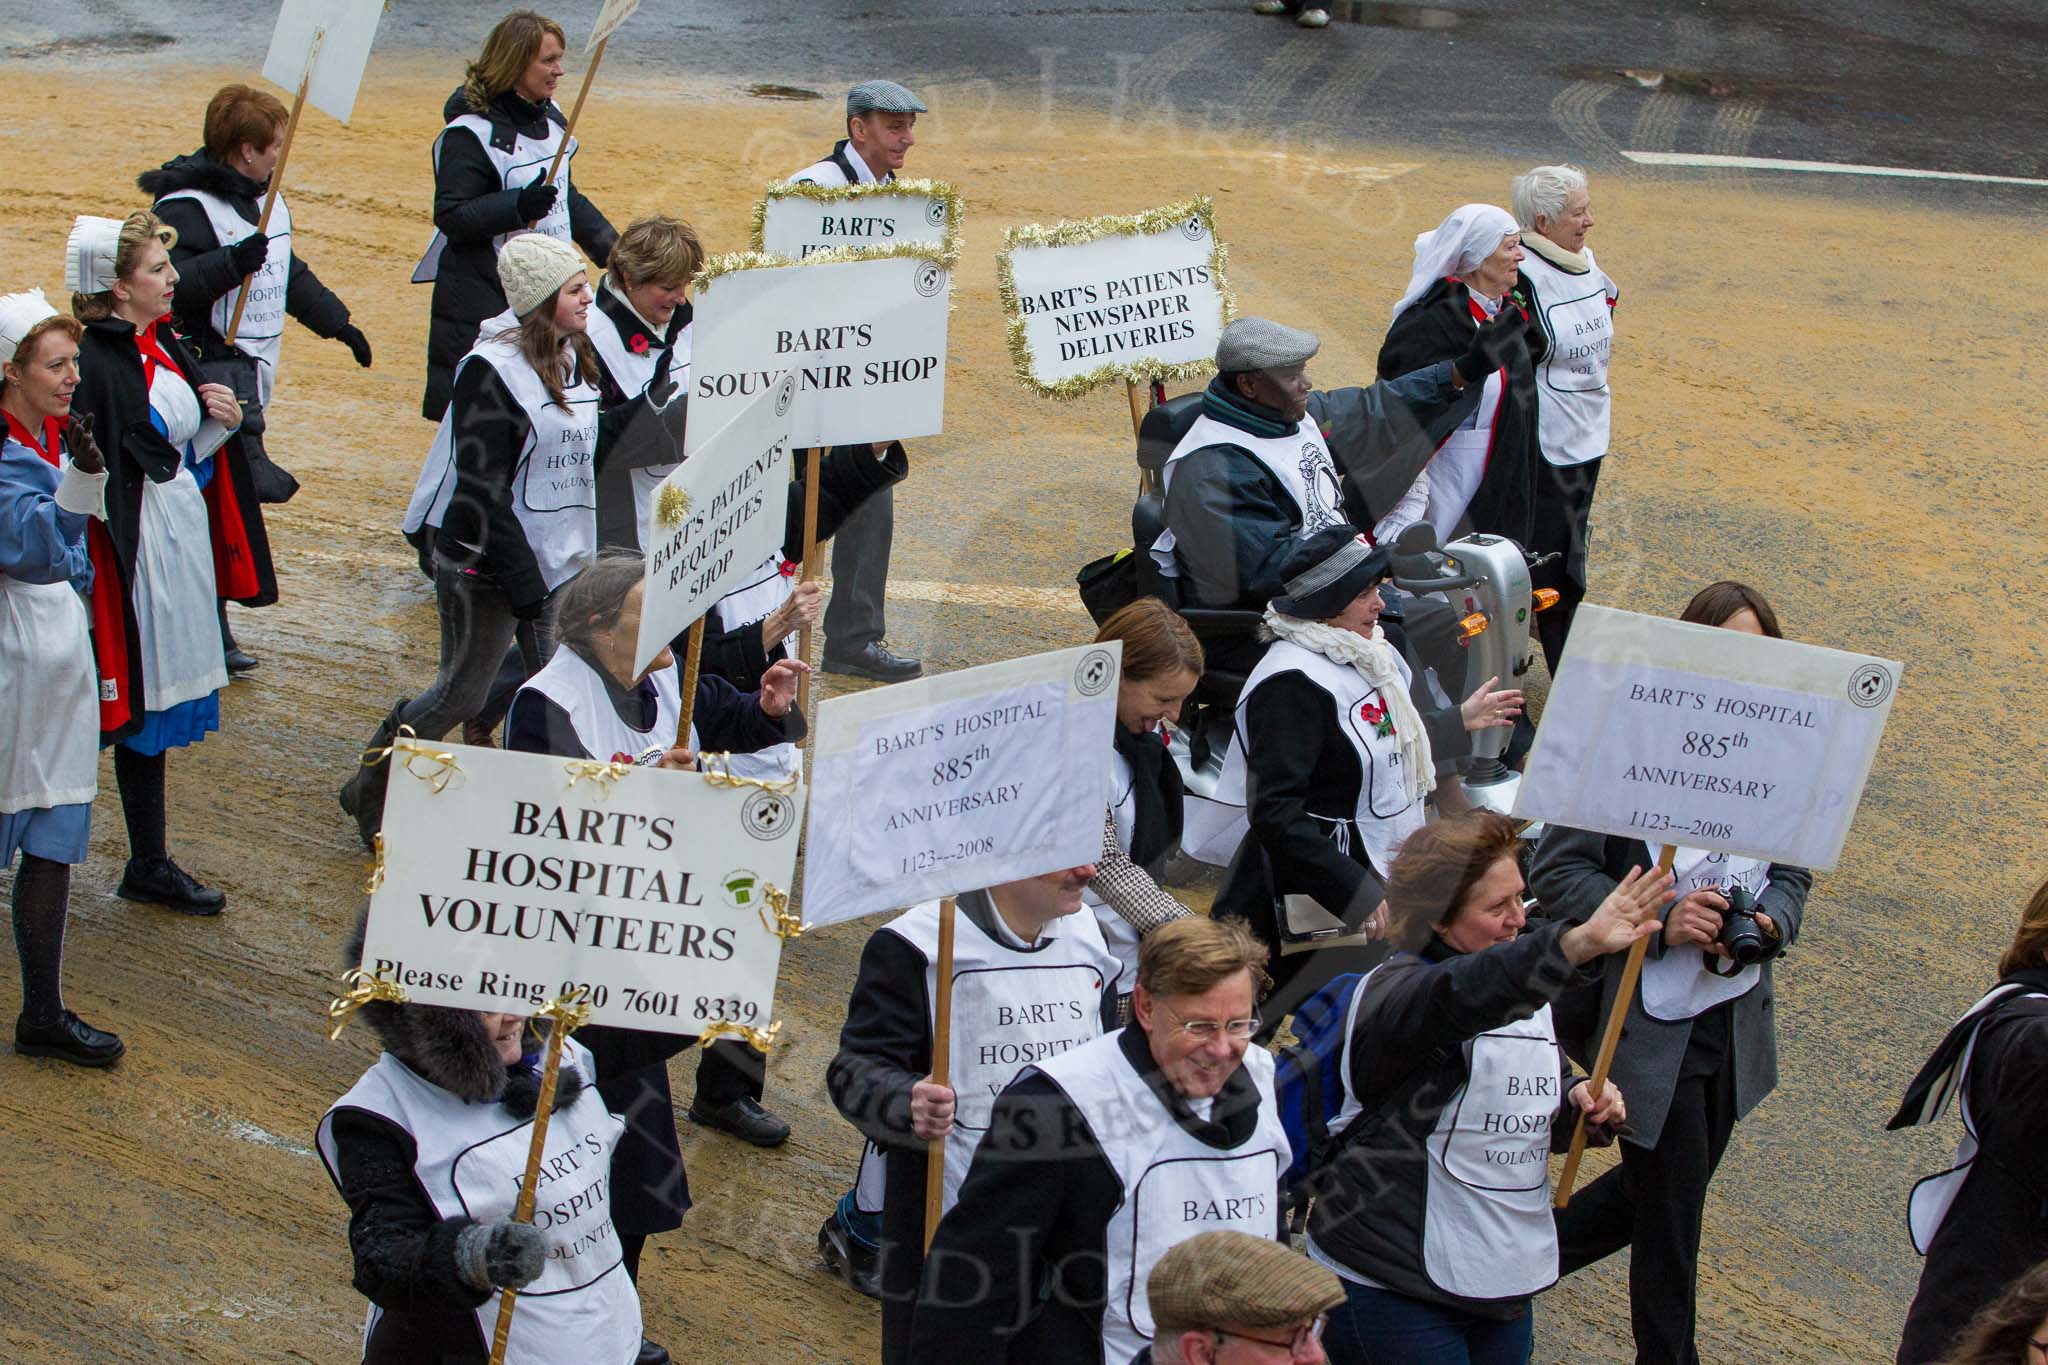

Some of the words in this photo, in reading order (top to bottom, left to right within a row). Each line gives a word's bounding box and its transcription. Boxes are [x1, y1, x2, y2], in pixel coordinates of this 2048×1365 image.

[821, 216, 895, 238] BART'S
[1021, 284, 1097, 315] BART'S
[1106, 264, 1209, 301] PATIENTS
[1055, 294, 1190, 336] NEWSPAPER
[775, 324, 872, 354] BART'S
[1059, 319, 1195, 362] DELIVERIES
[698, 365, 852, 399] SOUVNIR
[863, 356, 938, 386] SHOP
[653, 510, 705, 577] BART'S
[669, 489, 763, 591] REQUISITES
[688, 549, 734, 603] SHOP
[876, 723, 945, 755] BART'S
[955, 701, 1047, 736] HOSPITAL
[1629, 684, 1707, 710] BART'S
[1714, 698, 1816, 728] HOSPITAL
[932, 744, 990, 787] 885th
[1682, 730, 1749, 759] 885th
[1623, 765, 1776, 800] ANNIVERSARY
[510, 800, 676, 851] BART'S
[885, 782, 1024, 833] ANNIVERSARY
[462, 847, 705, 907] HOSPITAL
[418, 894, 736, 962] VOLUNTEERS
[374, 959, 463, 992] Please
[479, 971, 546, 1004] Ring
[560, 980, 608, 1009] 020
[622, 988, 680, 1017] 7601
[694, 996, 758, 1024] 8339
[998, 1000, 1083, 1026] BART'S
[979, 1037, 1091, 1065] HOSPIT
